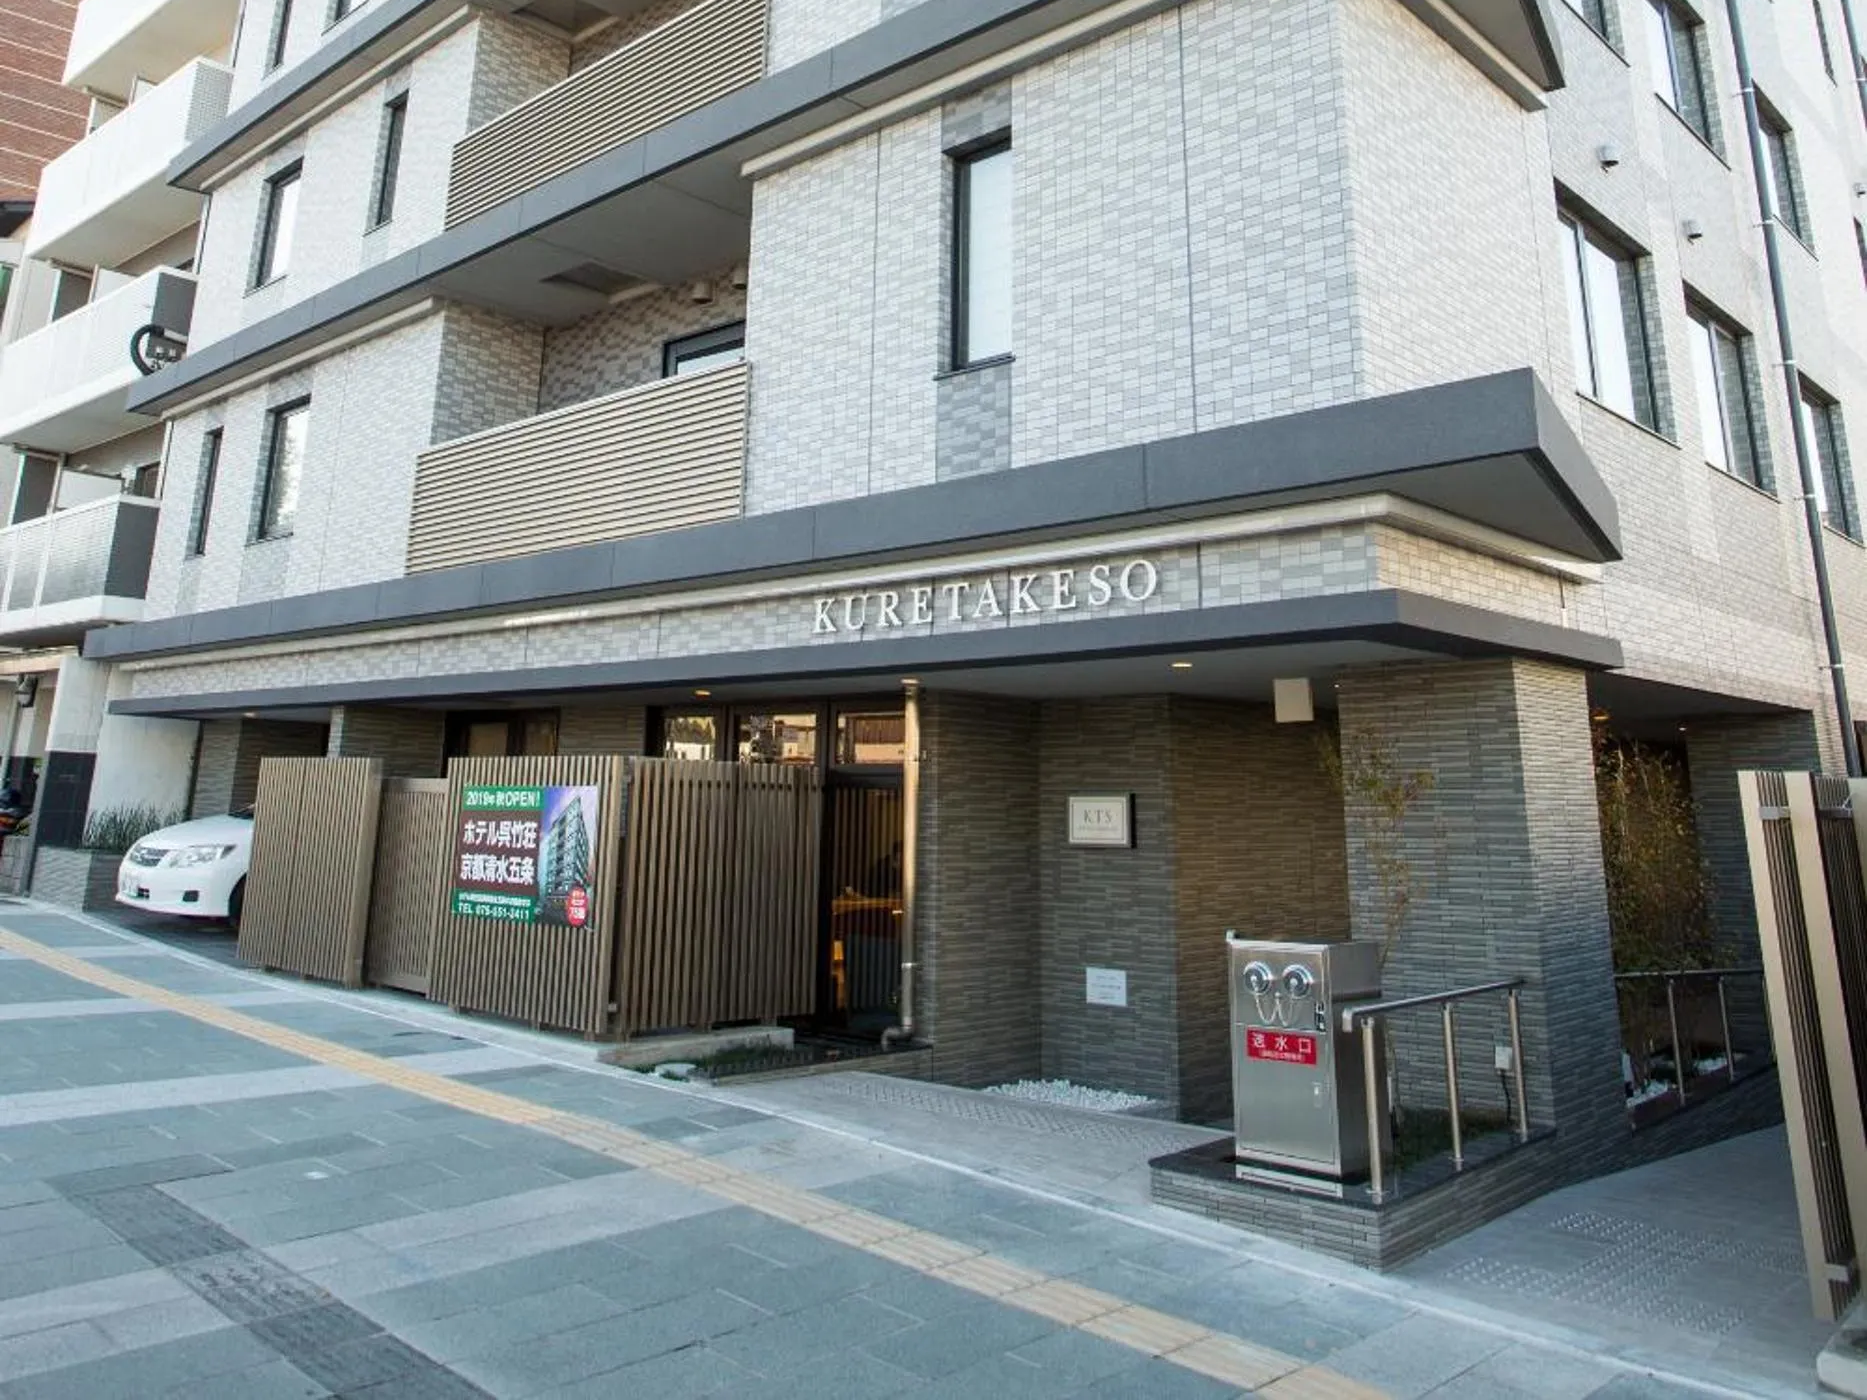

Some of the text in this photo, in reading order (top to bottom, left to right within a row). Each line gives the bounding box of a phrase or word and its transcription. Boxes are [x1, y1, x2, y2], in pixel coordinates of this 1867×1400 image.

[812, 559, 1157, 635] KURETAKESO
[463, 820, 538, 849] ホテル呉竹荘
[460, 853, 535, 885] 京都清水五条
[458, 902, 473, 914] TEL
[1251, 1031, 1312, 1055] 送水口
